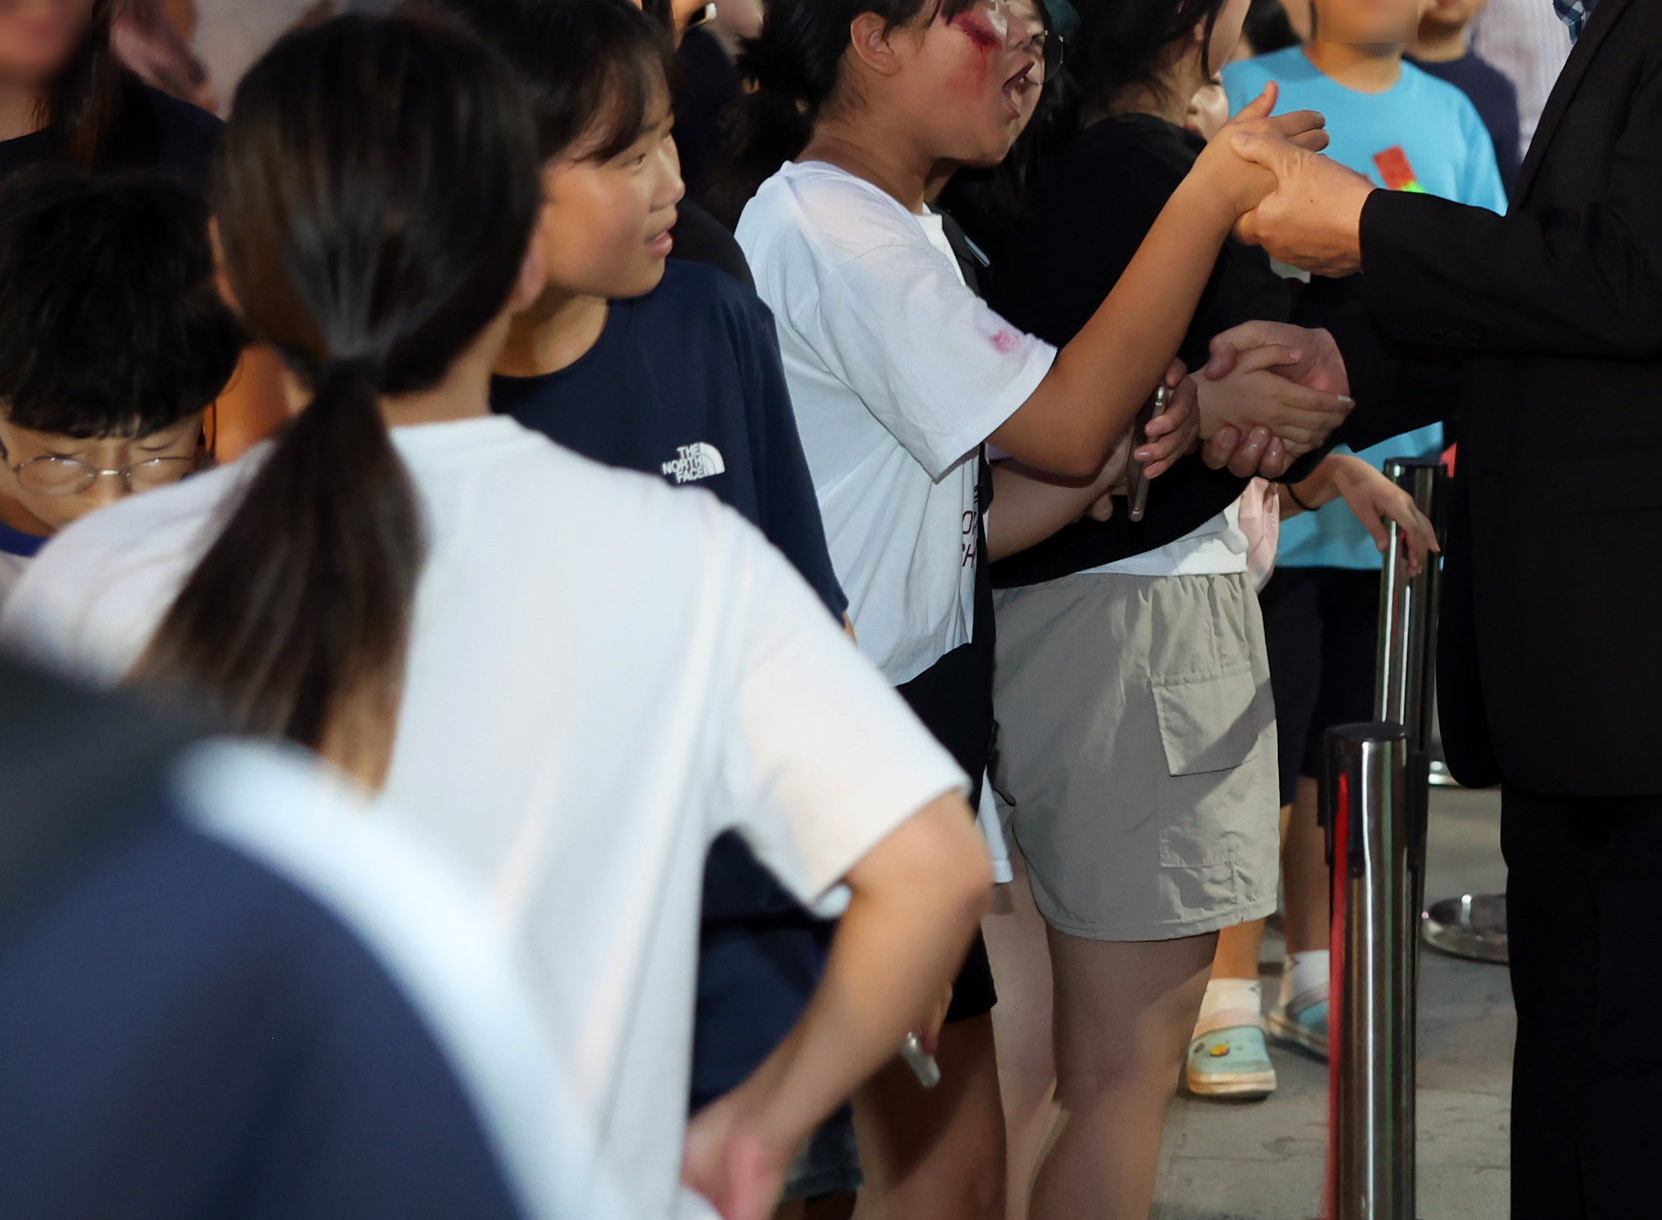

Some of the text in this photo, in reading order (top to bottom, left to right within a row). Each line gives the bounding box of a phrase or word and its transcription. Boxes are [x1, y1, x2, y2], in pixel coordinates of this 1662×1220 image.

[676, 442, 701, 460] THE
[661, 454, 703, 475] NORTH
[675, 466, 705, 484] FACE
